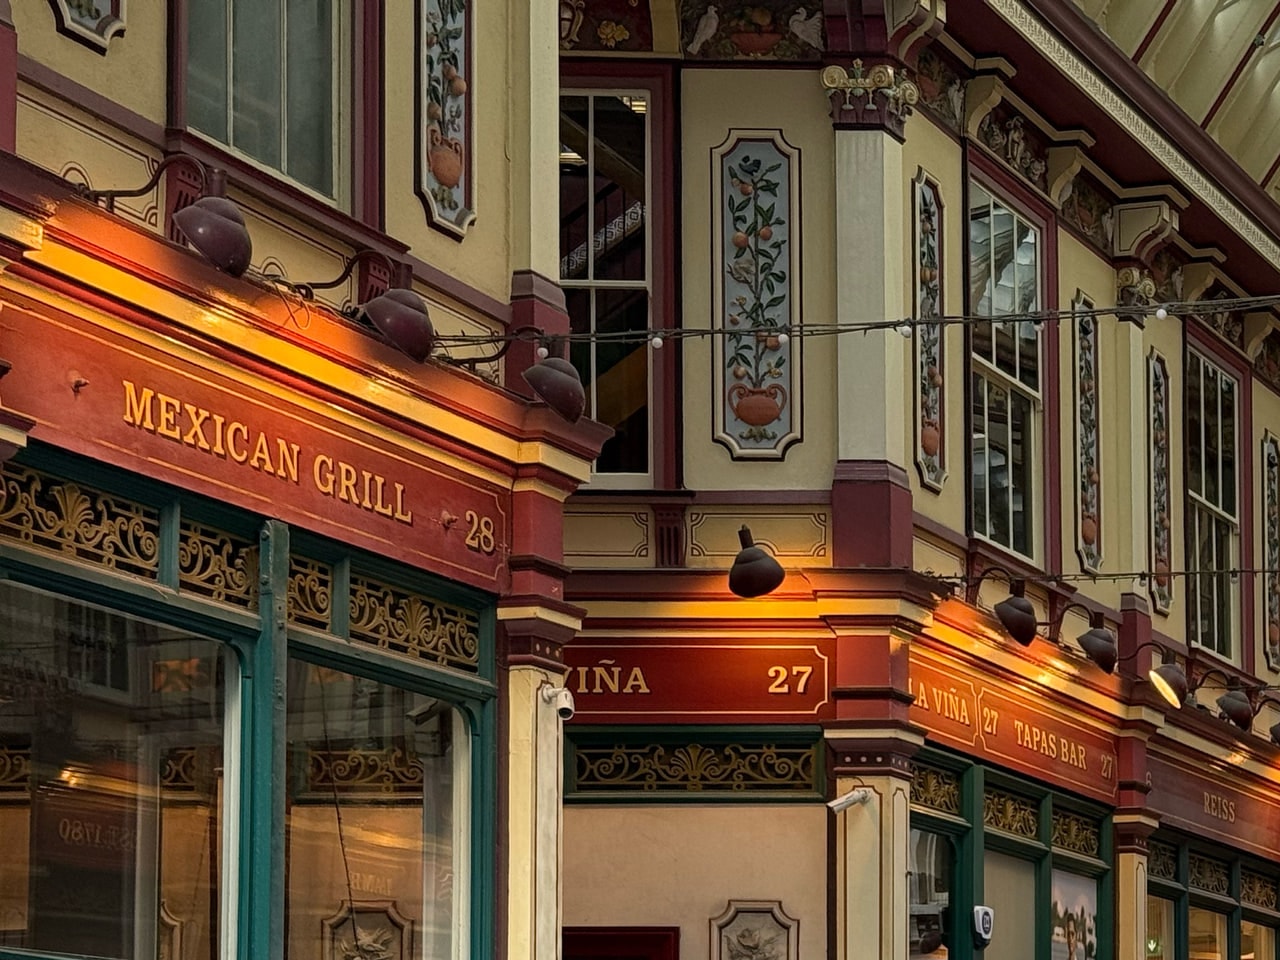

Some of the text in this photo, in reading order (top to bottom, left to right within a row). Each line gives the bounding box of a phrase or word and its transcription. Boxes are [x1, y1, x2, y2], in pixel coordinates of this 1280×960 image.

[122, 380, 413, 525] MEXICAN GRILL
[465, 509, 496, 553] 28
[767, 666, 813, 694] 27
[931, 688, 971, 726] VIÑA
[983, 706, 999, 736] 27
[1014, 719, 1088, 771] TAPAS BAR
[1101, 754, 1113, 780] 27
[1204, 791, 1236, 824] REISS
